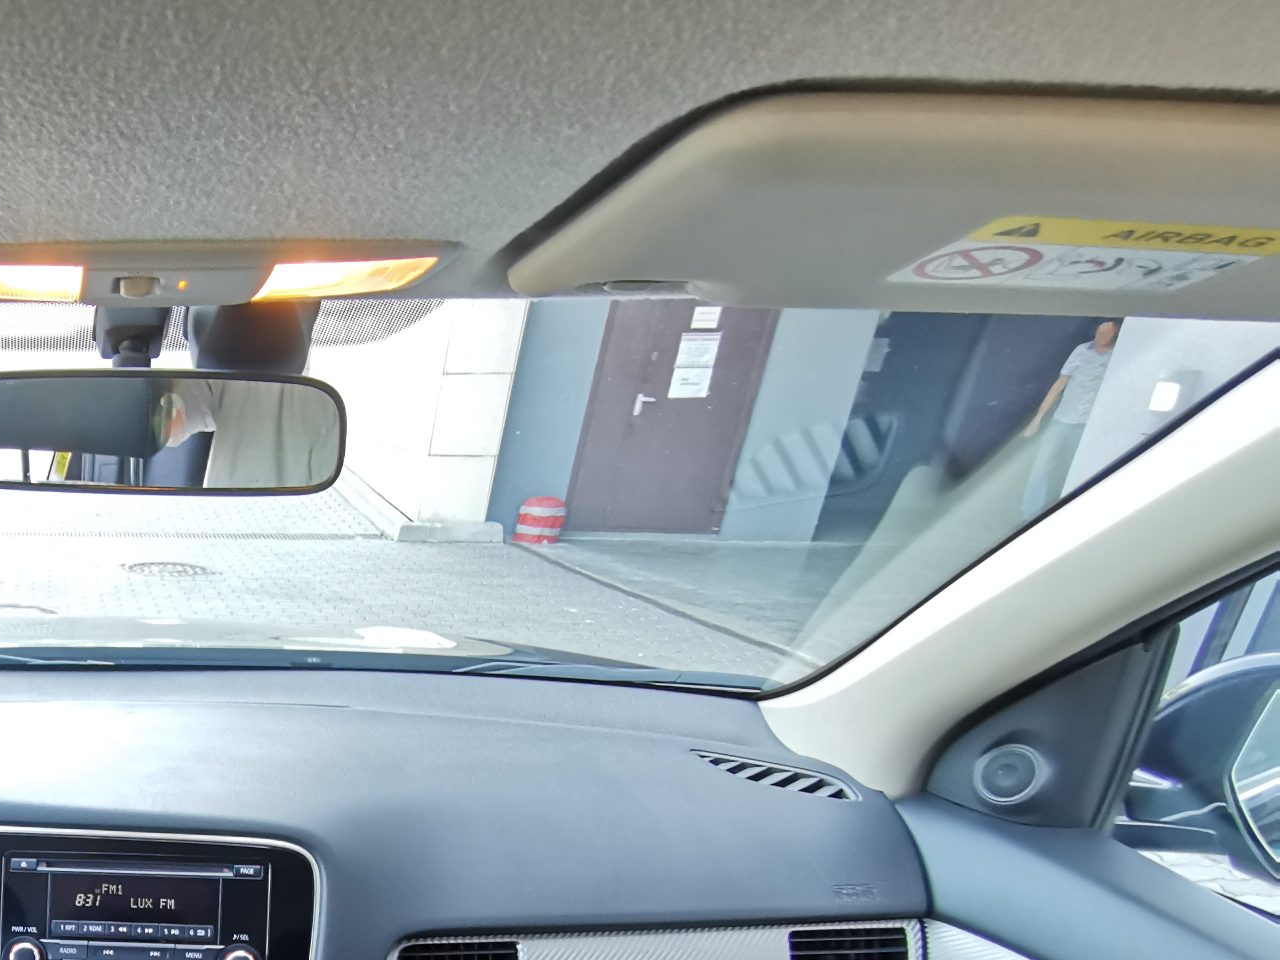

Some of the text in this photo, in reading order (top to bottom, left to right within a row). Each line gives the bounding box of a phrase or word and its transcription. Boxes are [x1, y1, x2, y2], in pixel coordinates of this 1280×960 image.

[1101, 228, 1276, 249] AIRBAG
[101, 884, 123, 895] FM1
[130, 897, 176, 909] LUX FM
[60, 946, 77, 954] RADIO
[185, 951, 202, 959] MENU
